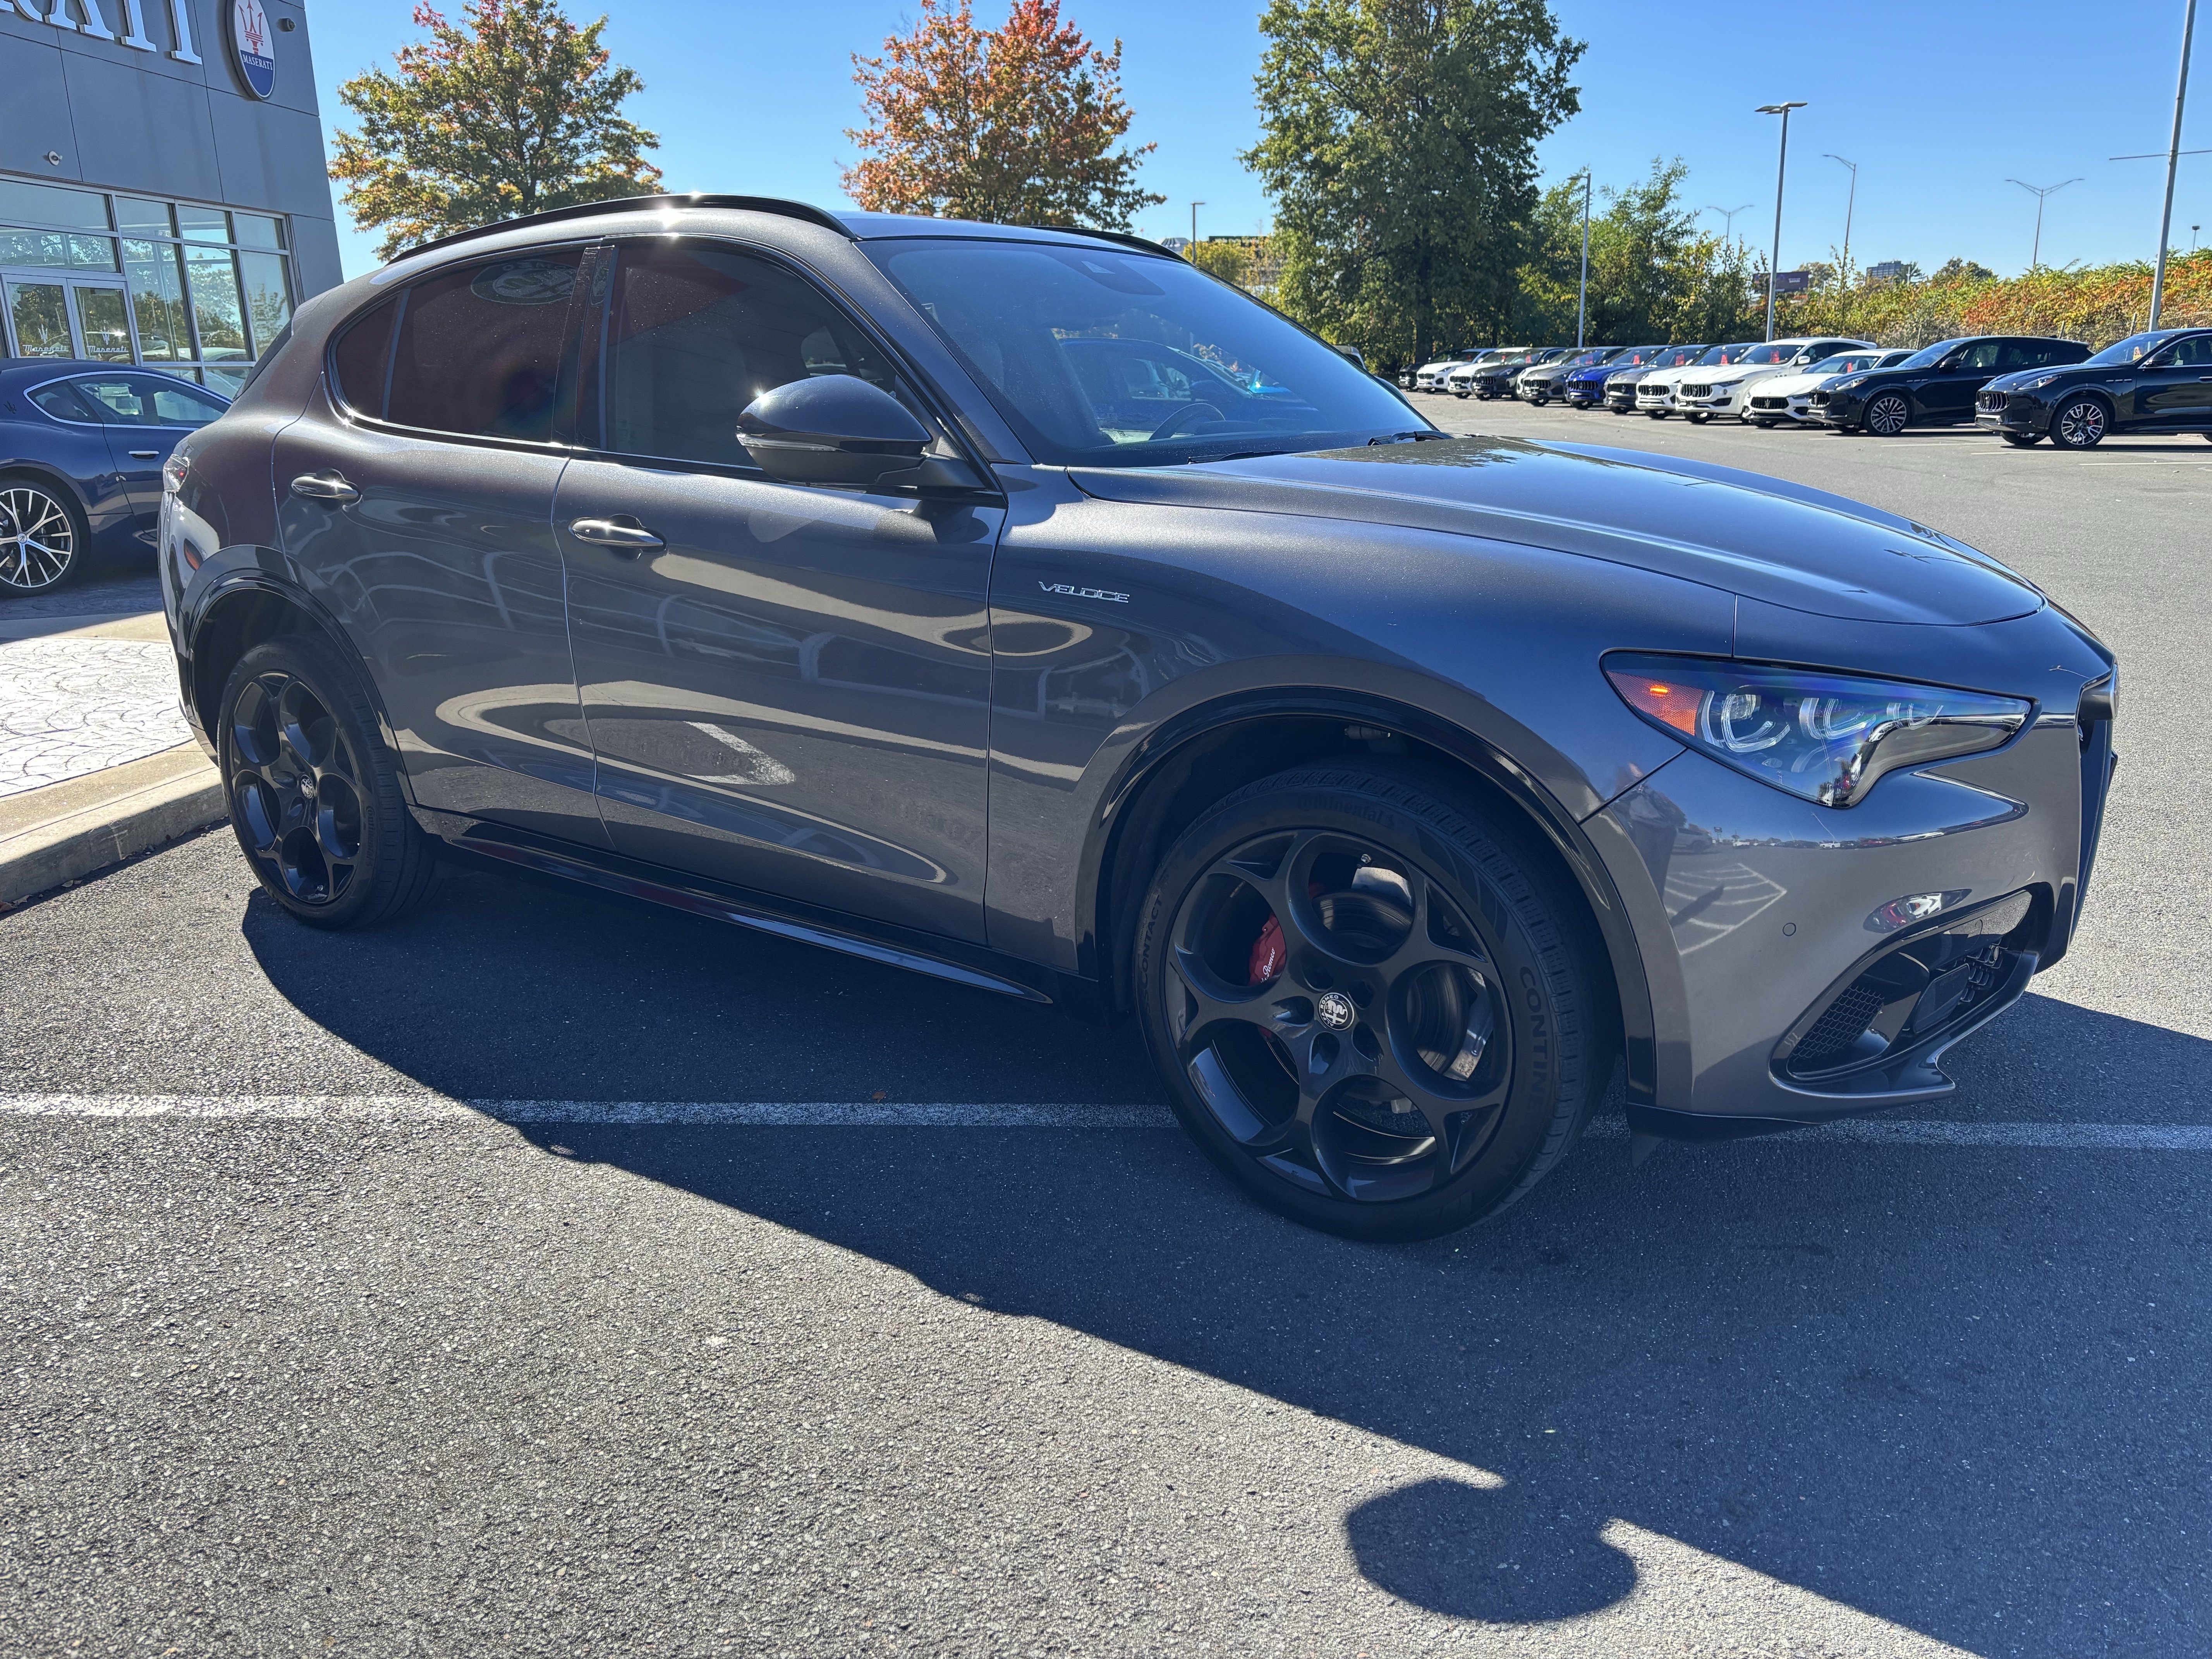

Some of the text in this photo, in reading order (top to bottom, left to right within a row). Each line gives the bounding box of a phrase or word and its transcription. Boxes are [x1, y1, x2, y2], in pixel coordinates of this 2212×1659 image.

[242, 54, 273, 70] MASERATI
[1038, 581, 1130, 603] VELOCE
[1263, 947, 1275, 977] Romeo
[1320, 994, 1339, 1027] ALFA ROMEO
